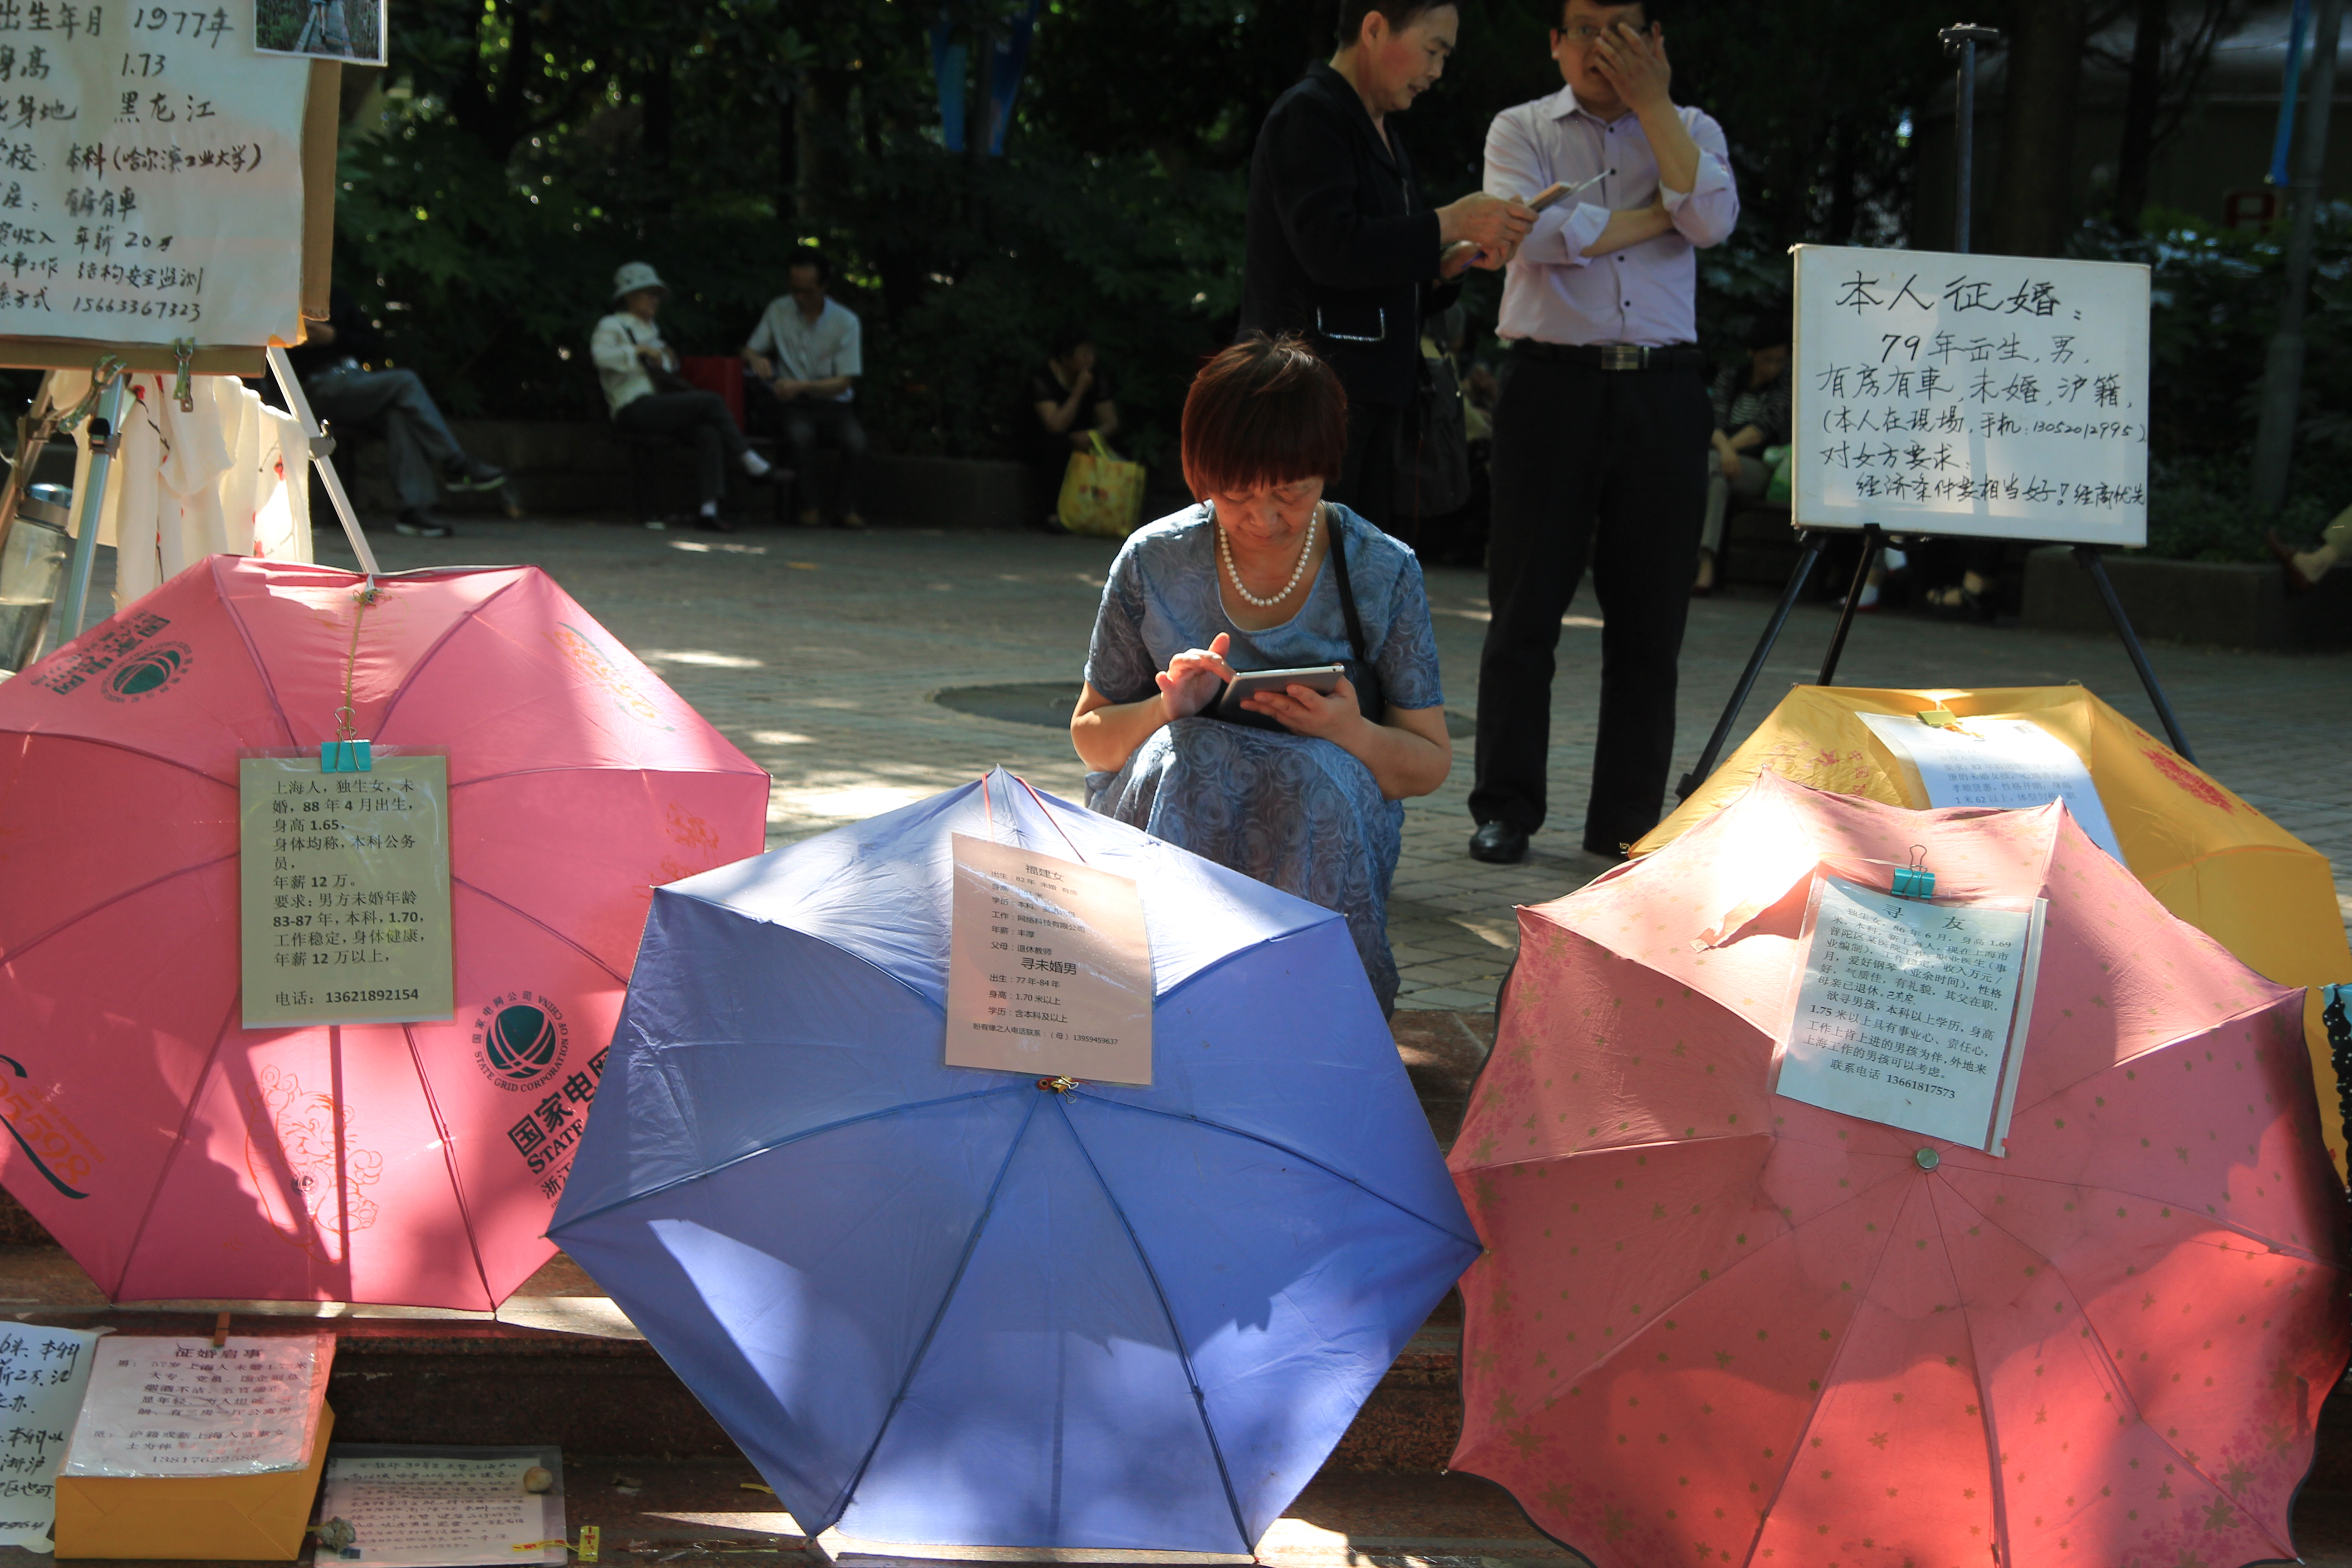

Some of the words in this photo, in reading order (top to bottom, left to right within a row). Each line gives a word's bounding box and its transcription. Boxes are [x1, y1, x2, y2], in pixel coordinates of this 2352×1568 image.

[134, 7, 235, 49] 1977年
[121, 52, 167, 78] 1.73
[113, 90, 216, 124] 黑龙江
[72, 296, 202, 323] 15663367323
[1025, 864, 1064, 882] 福建女
[1882, 903, 1905, 920] 寻
[1941, 916, 1965, 931] 友
[1020, 956, 1077, 976] 寻未婚男
[325, 988, 420, 1004] 13621892154
[538, 995, 563, 1021] CHINA
[558, 1022, 568, 1036] OF
[1073, 1033, 1118, 1046] 13959459637
[475, 1050, 495, 1080] STATE
[520, 1038, 569, 1093] CORPORATION
[494, 1078, 519, 1093] GRID
[1830, 1058, 1881, 1080] 联系电话
[1886, 1074, 1956, 1099] 13661817573
